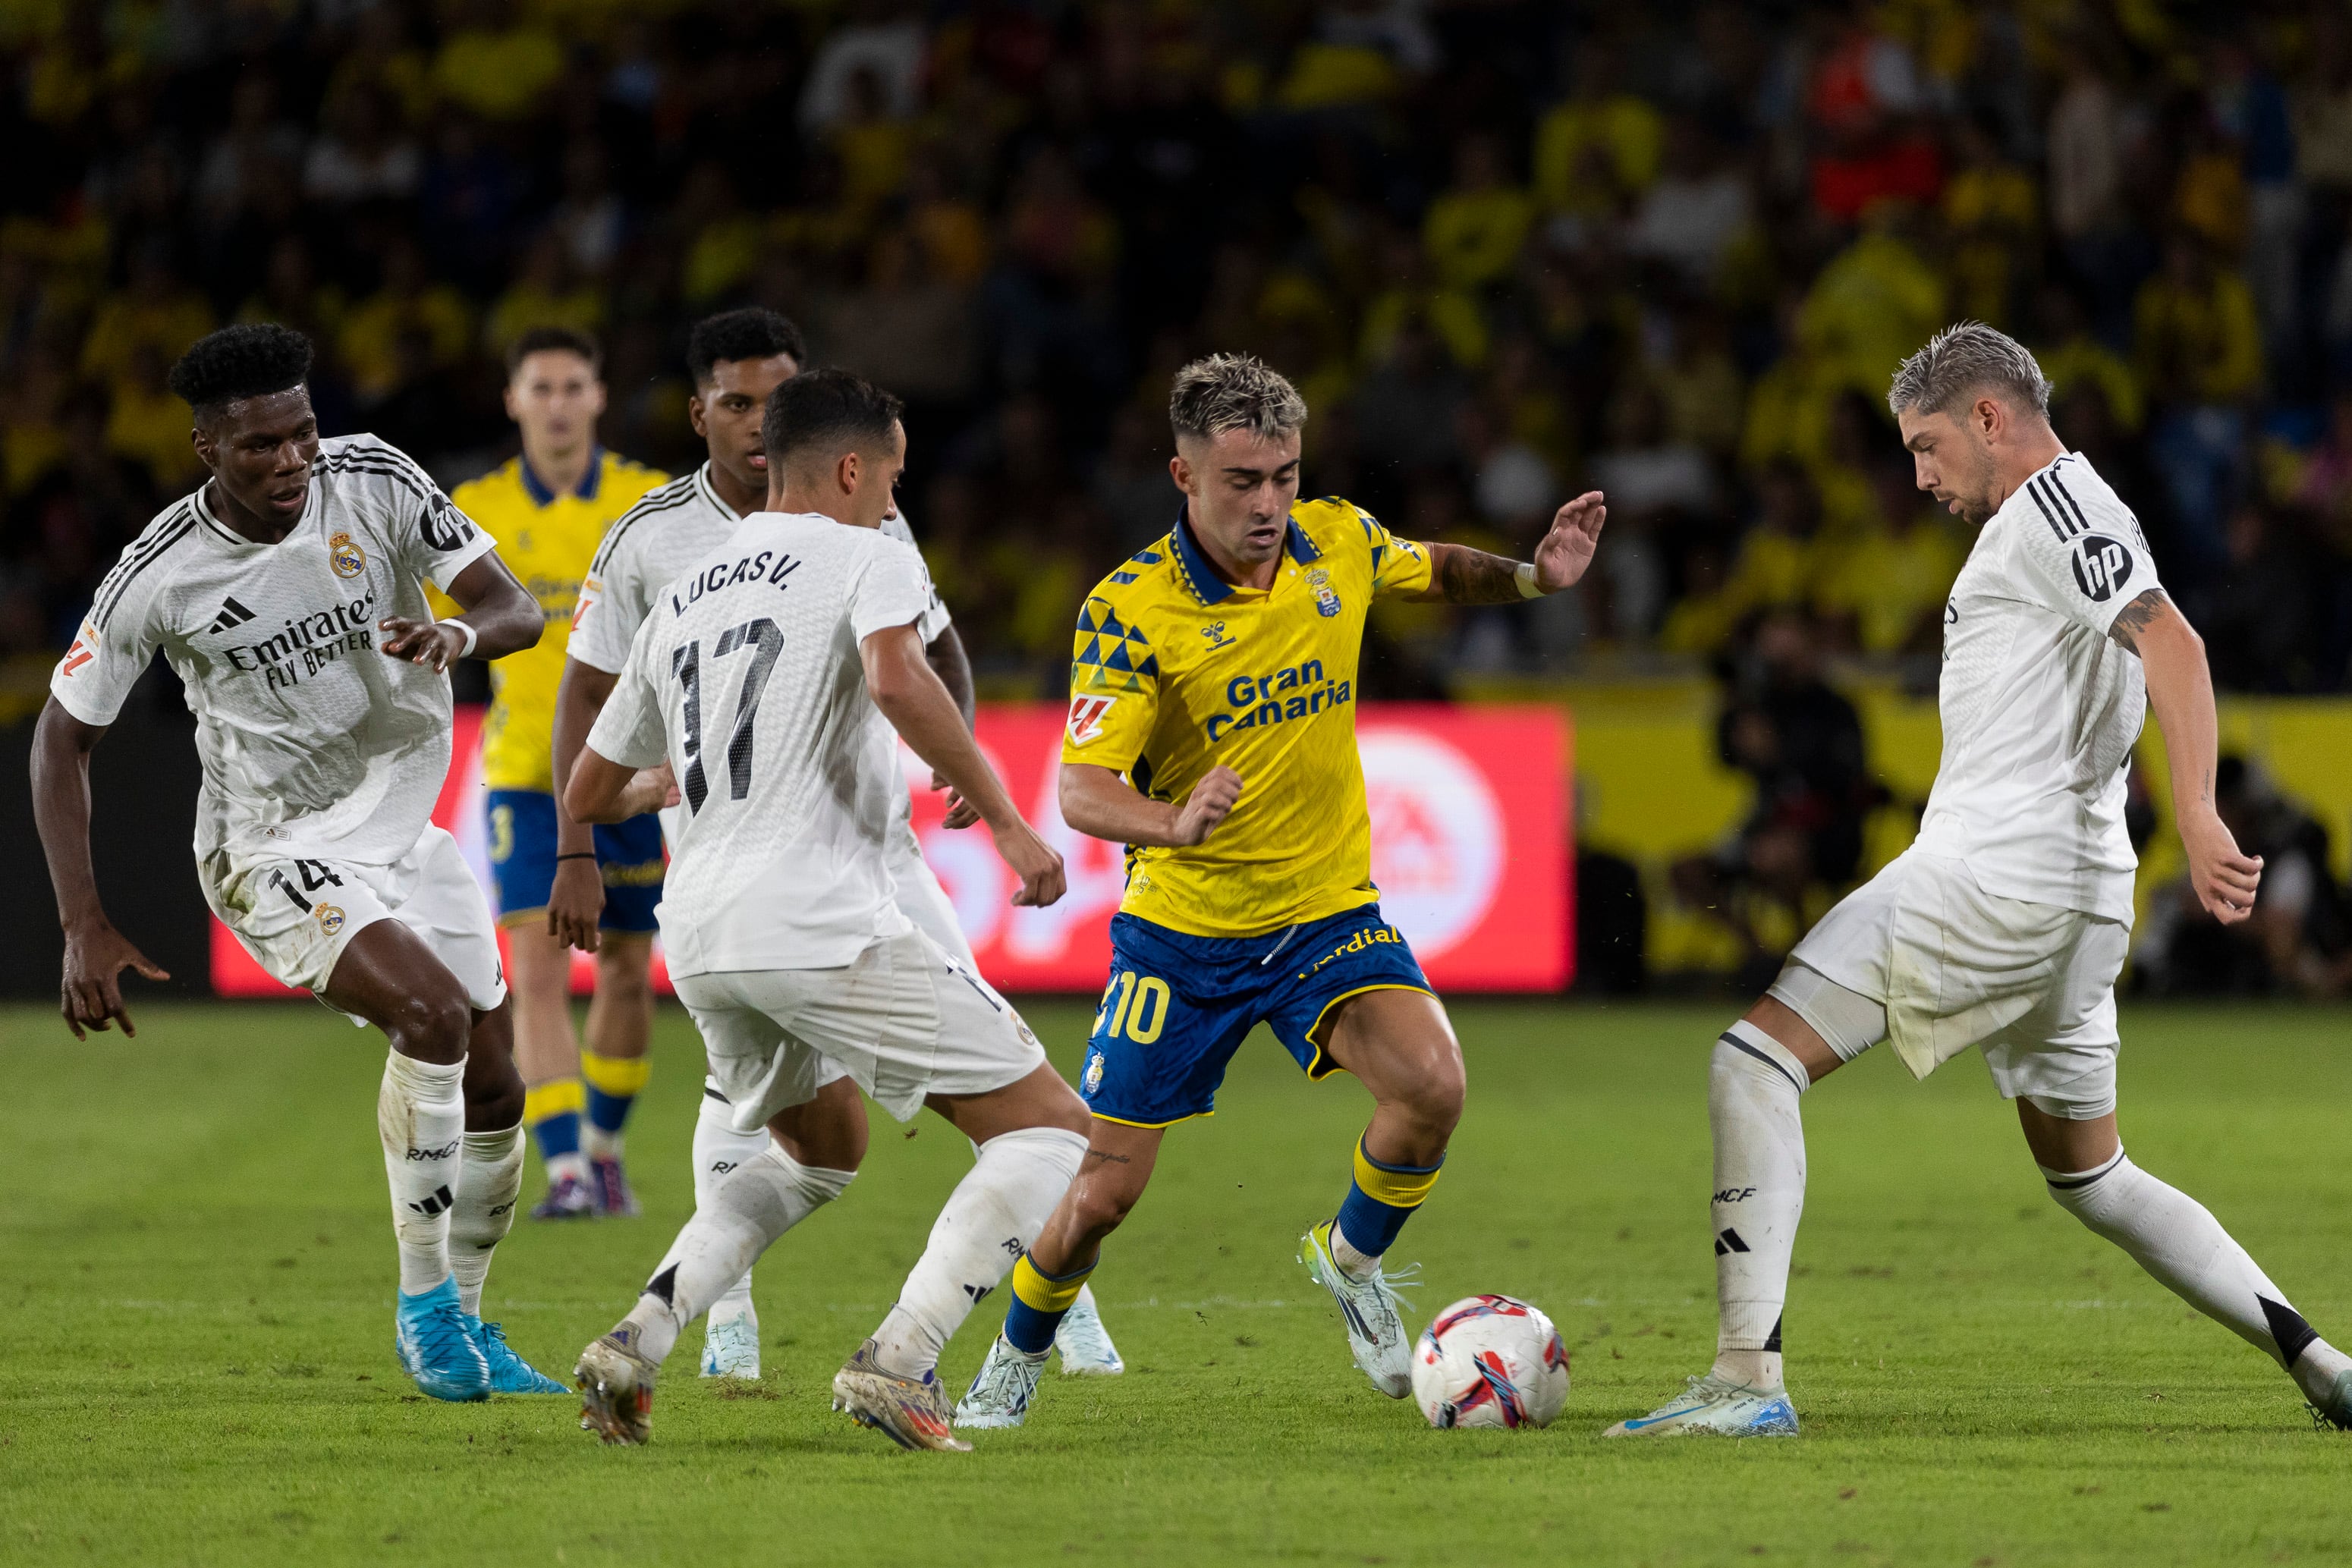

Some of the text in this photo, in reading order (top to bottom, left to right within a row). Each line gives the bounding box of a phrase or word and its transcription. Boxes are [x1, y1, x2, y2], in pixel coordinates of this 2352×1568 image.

[672, 551, 802, 617] LUCAS V.
[2074, 537, 2130, 600] hp
[222, 588, 374, 671] Emirates
[266, 630, 373, 690] FLY BETTER
[1206, 680, 1351, 743] Canaria
[1226, 658, 1324, 708] Gran
[671, 617, 785, 819] 17
[268, 859, 344, 915] 14
[1108, 971, 1171, 1045] 10
